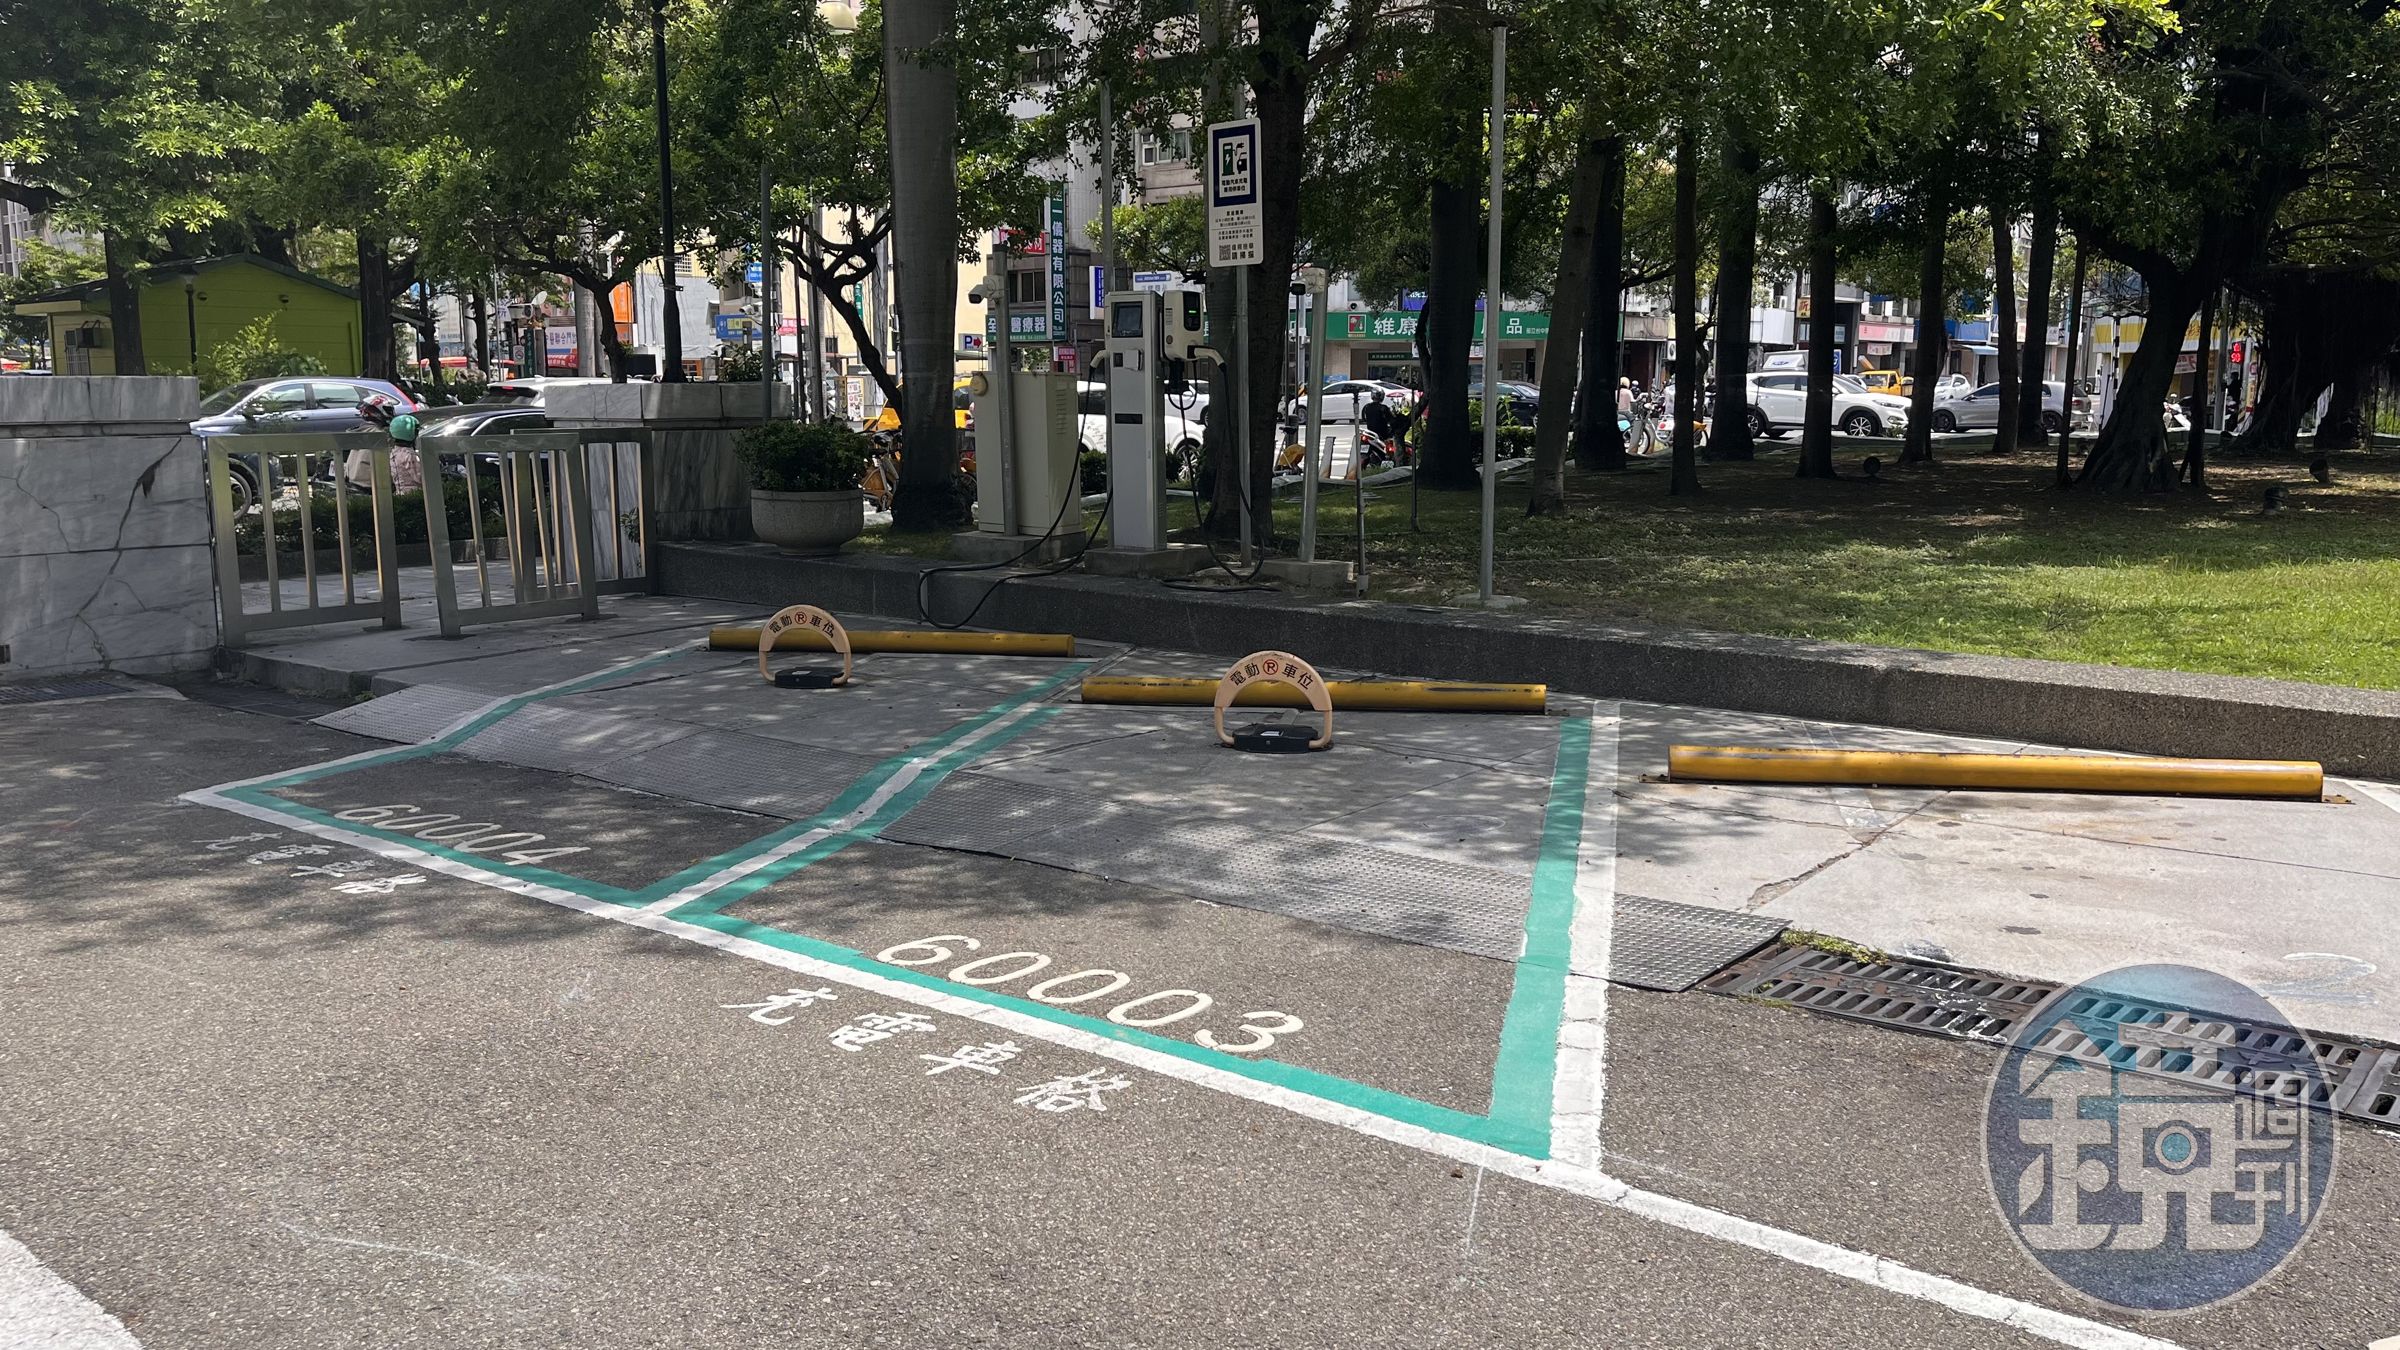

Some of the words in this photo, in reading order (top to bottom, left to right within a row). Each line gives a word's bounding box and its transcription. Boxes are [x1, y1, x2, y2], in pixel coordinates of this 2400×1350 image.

[964, 335, 973, 349] P
[333, 804, 592, 867] 60004
[876, 934, 1305, 1053] 60003
[719, 986, 1133, 1113] 充電車格
